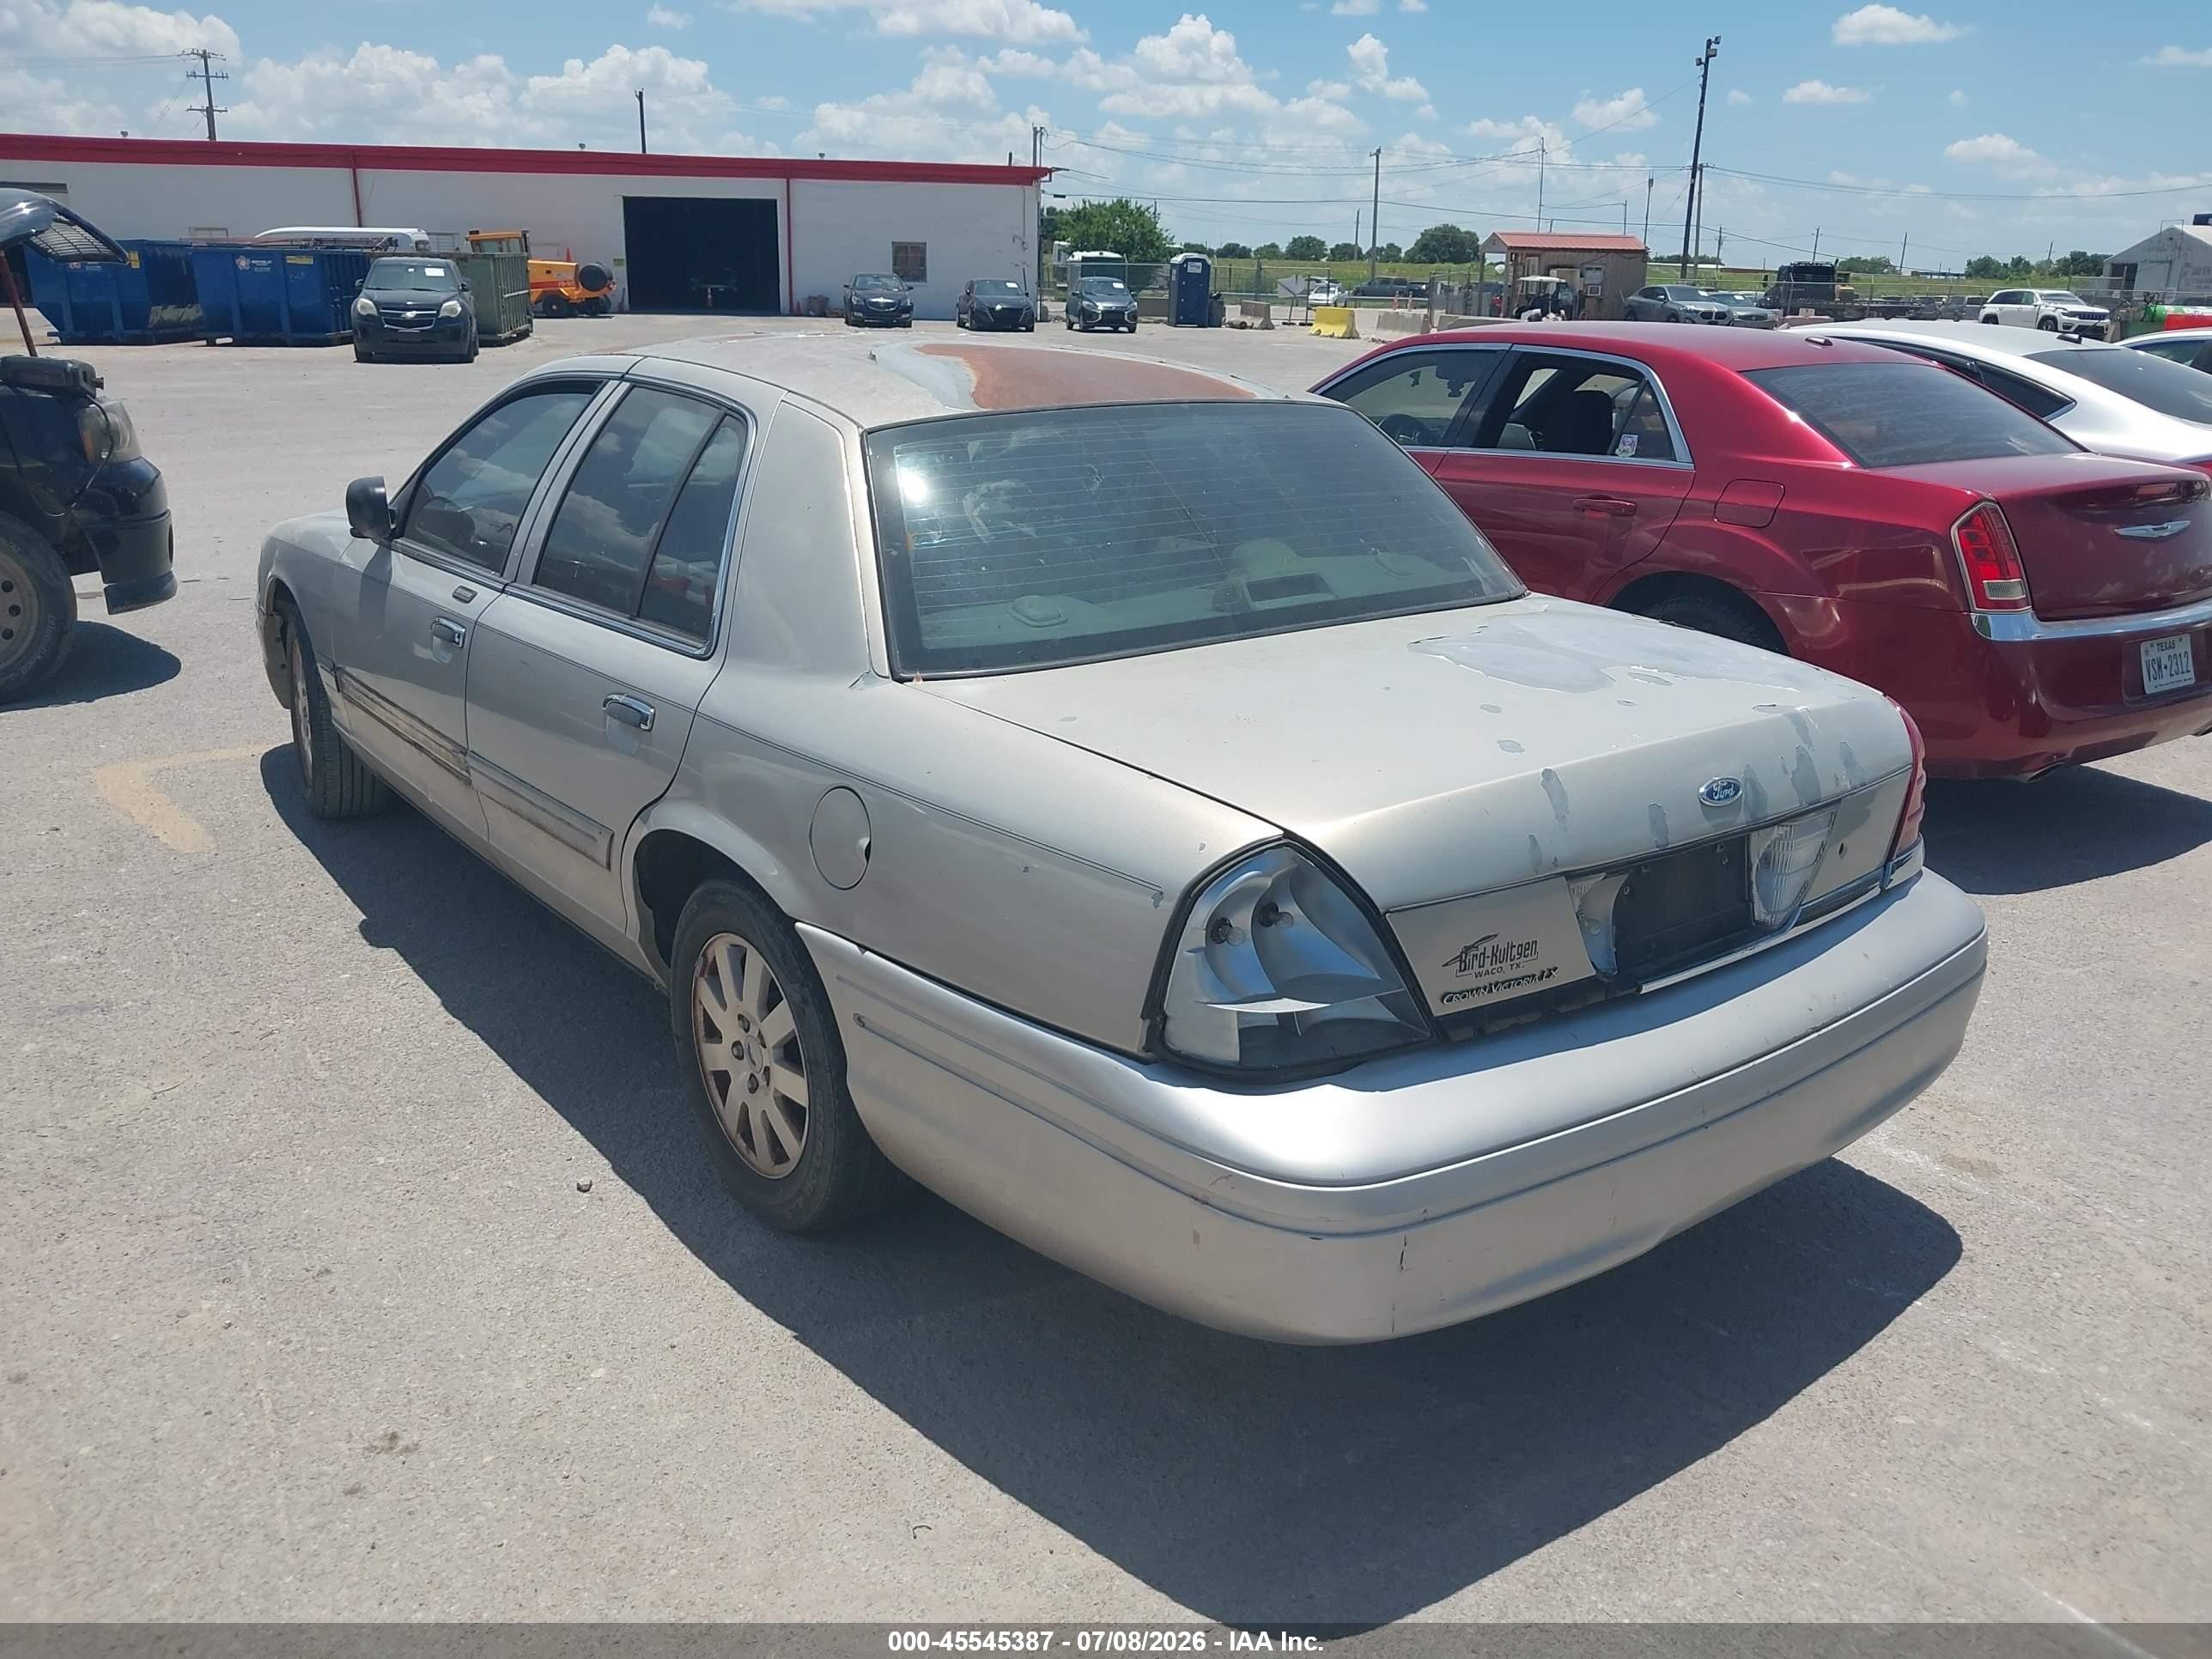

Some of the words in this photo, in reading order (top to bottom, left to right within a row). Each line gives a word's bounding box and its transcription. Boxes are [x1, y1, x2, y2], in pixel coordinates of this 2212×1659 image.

[2156, 639, 2176, 652] TEXAS
[1712, 780, 1735, 800] Ford
[1458, 939, 1538, 973] Bird-Kultgen
[1474, 967, 1505, 979] WACO,
[1540, 968, 1559, 981] LX
